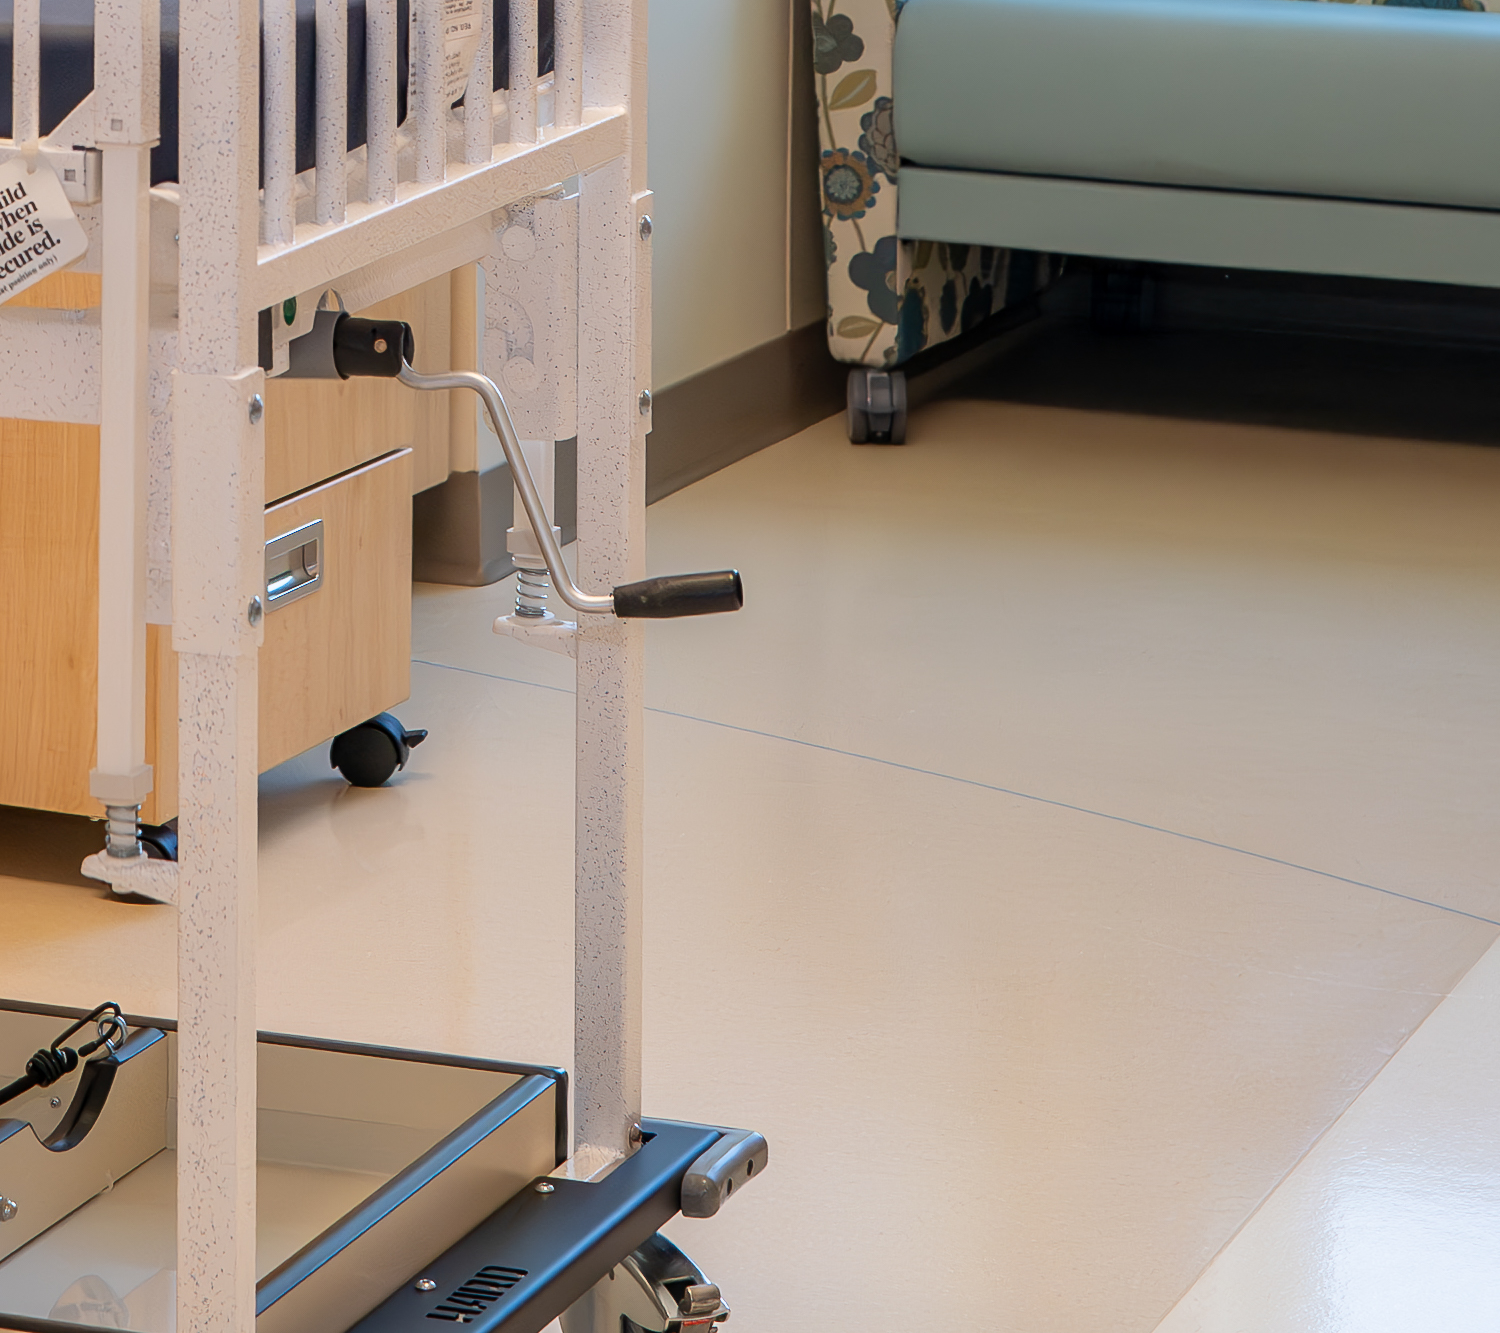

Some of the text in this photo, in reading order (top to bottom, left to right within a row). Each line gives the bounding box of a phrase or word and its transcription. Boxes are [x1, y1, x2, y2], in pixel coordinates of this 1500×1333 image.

[27, 217, 44, 236] is
[8, 268, 38, 293] position
[38, 254, 58, 271] only)
[425, 1265, 529, 1323] HARD
